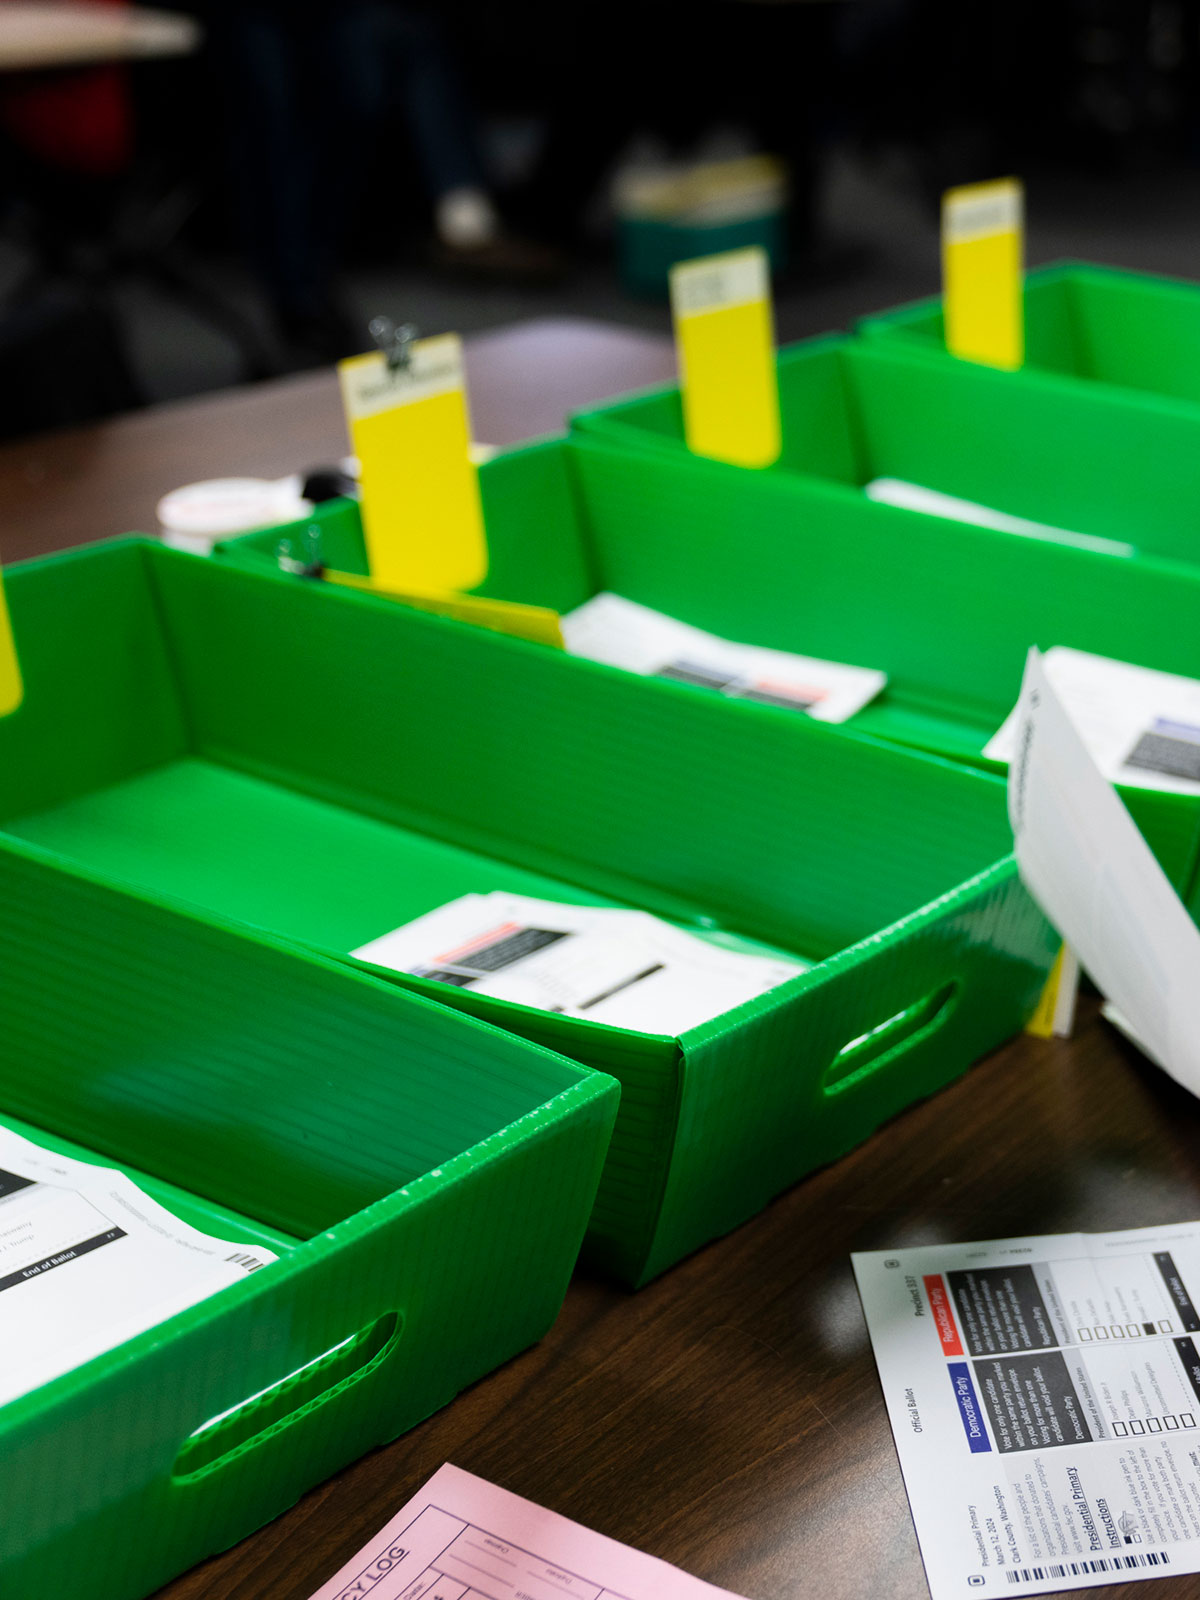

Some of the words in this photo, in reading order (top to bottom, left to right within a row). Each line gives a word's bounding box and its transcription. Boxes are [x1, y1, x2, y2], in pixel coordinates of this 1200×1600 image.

[22, 1265, 41, 1278] End
[41, 1261, 52, 1270] of
[50, 1250, 77, 1265] Ballot
[930, 1287, 943, 1305] Party
[936, 1305, 954, 1343] Republican
[991, 1362, 1005, 1381] marked
[1075, 1366, 1085, 1382] States
[956, 1376, 969, 1395] Party
[986, 1378, 999, 1403] candidate
[999, 1381, 1010, 1391] you
[1025, 1379, 1033, 1390] one
[1038, 1382, 1050, 1394] your
[1079, 1382, 1091, 1399] United
[904, 1387, 917, 1408] Ballot
[1002, 1391, 1014, 1405] party
[1016, 1392, 1027, 1409] return
[1028, 1390, 1038, 1403] than
[1040, 1394, 1052, 1406] void
[1063, 1396, 1074, 1410] Party
[1087, 1399, 1095, 1408] the
[960, 1396, 981, 1438] Democratic
[994, 1404, 1002, 1414] one
[1007, 1406, 1017, 1420] same
[1020, 1409, 1032, 1425] ballot
[1032, 1403, 1043, 1417] more
[1044, 1406, 1055, 1416] will
[908, 1408, 923, 1433] Official
[996, 1414, 1006, 1426] only
[1011, 1420, 1020, 1430] the
[1037, 1418, 1045, 1426] for
[1068, 1410, 1085, 1440] Democratic
[1092, 1414, 1106, 1438] President
[1000, 1427, 1009, 1436] for
[1026, 1425, 1038, 1438] your
[1040, 1426, 1051, 1444] Voting
[1050, 1416, 1064, 1442] candidate
[1003, 1436, 1012, 1449] Vote
[1014, 1430, 1026, 1448] within
[1031, 1438, 1038, 1446] on
[1012, 1482, 1022, 1494] and
[1065, 1467, 1084, 1499] Primary
[1025, 1480, 1039, 1504] donated
[993, 1484, 1008, 1521] Washington
[1016, 1494, 1031, 1514] people
[1033, 1504, 1043, 1517] that
[967, 1504, 979, 1529] Primary
[984, 1517, 996, 1533] 2024
[1023, 1515, 1032, 1526] the
[1096, 1498, 1120, 1549] Instructions
[1004, 1521, 1016, 1545] County,
[1074, 1500, 1101, 1551] Presidential
[990, 1534, 999, 1544] 12,
[1028, 1533, 1037, 1542] list
[1038, 1517, 1056, 1557] organizations
[972, 1530, 990, 1567] Presidential
[992, 1545, 1005, 1565] March
[1009, 1546, 1021, 1563] Clark
[1033, 1548, 1042, 1559] For
[365, 1546, 406, 1581] LOG
